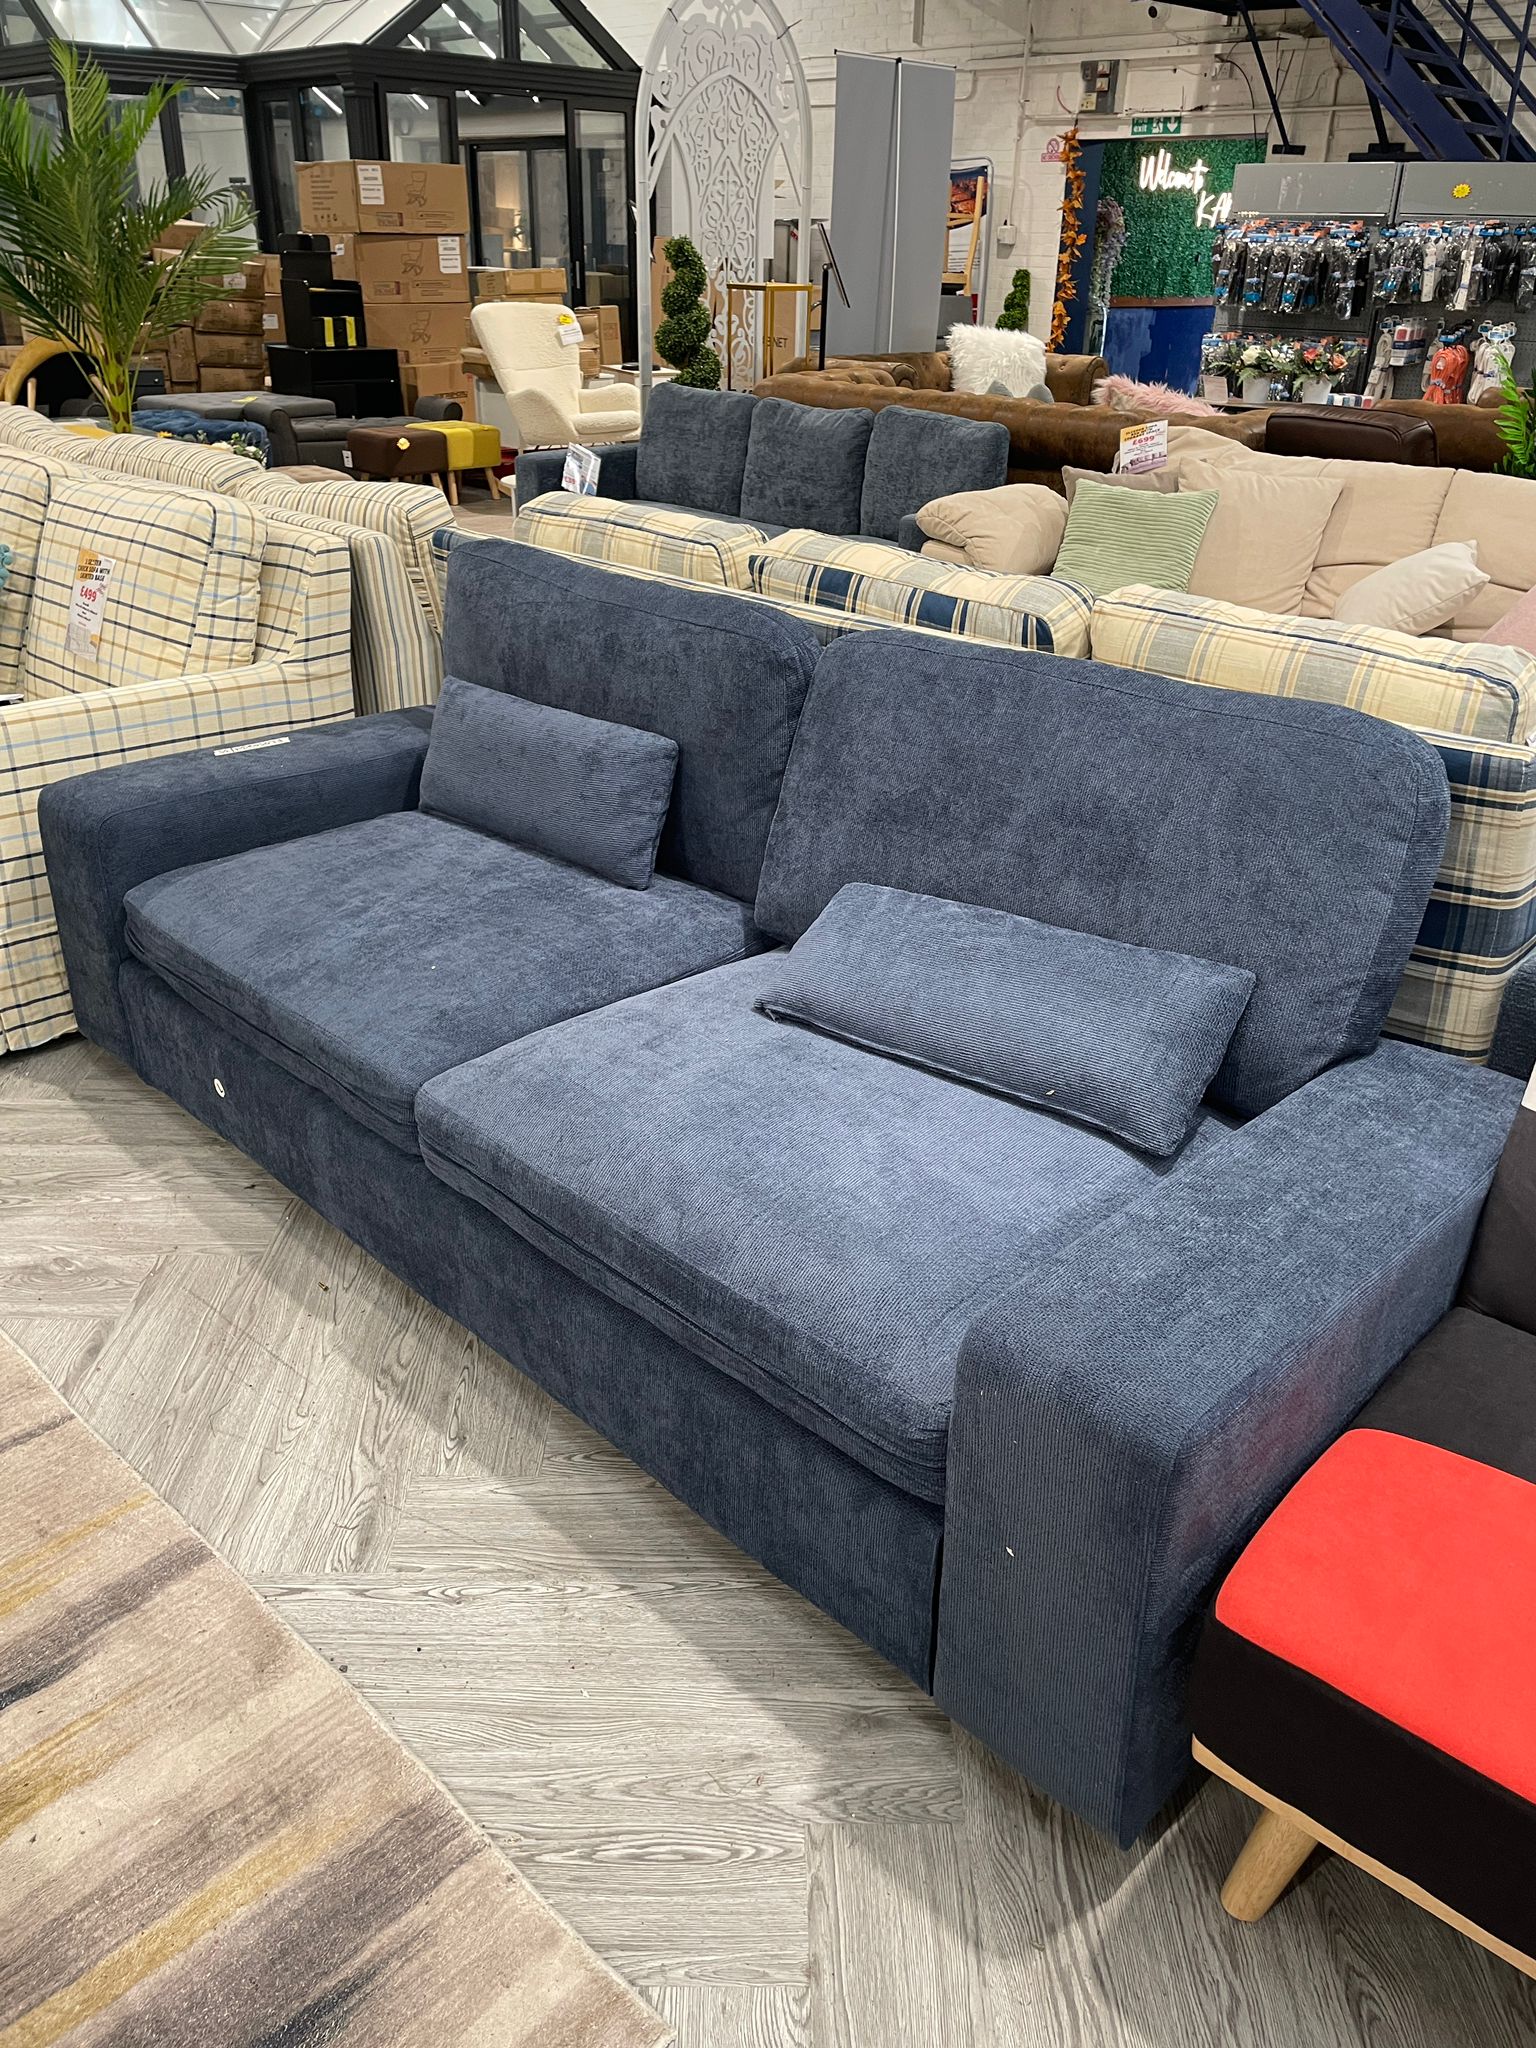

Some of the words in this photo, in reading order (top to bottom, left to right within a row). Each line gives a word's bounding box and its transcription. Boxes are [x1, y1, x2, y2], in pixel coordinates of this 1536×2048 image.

[1133, 124, 1148, 133] exit
[1132, 435, 1155, 446] £699
[79, 585, 97, 602] £499
